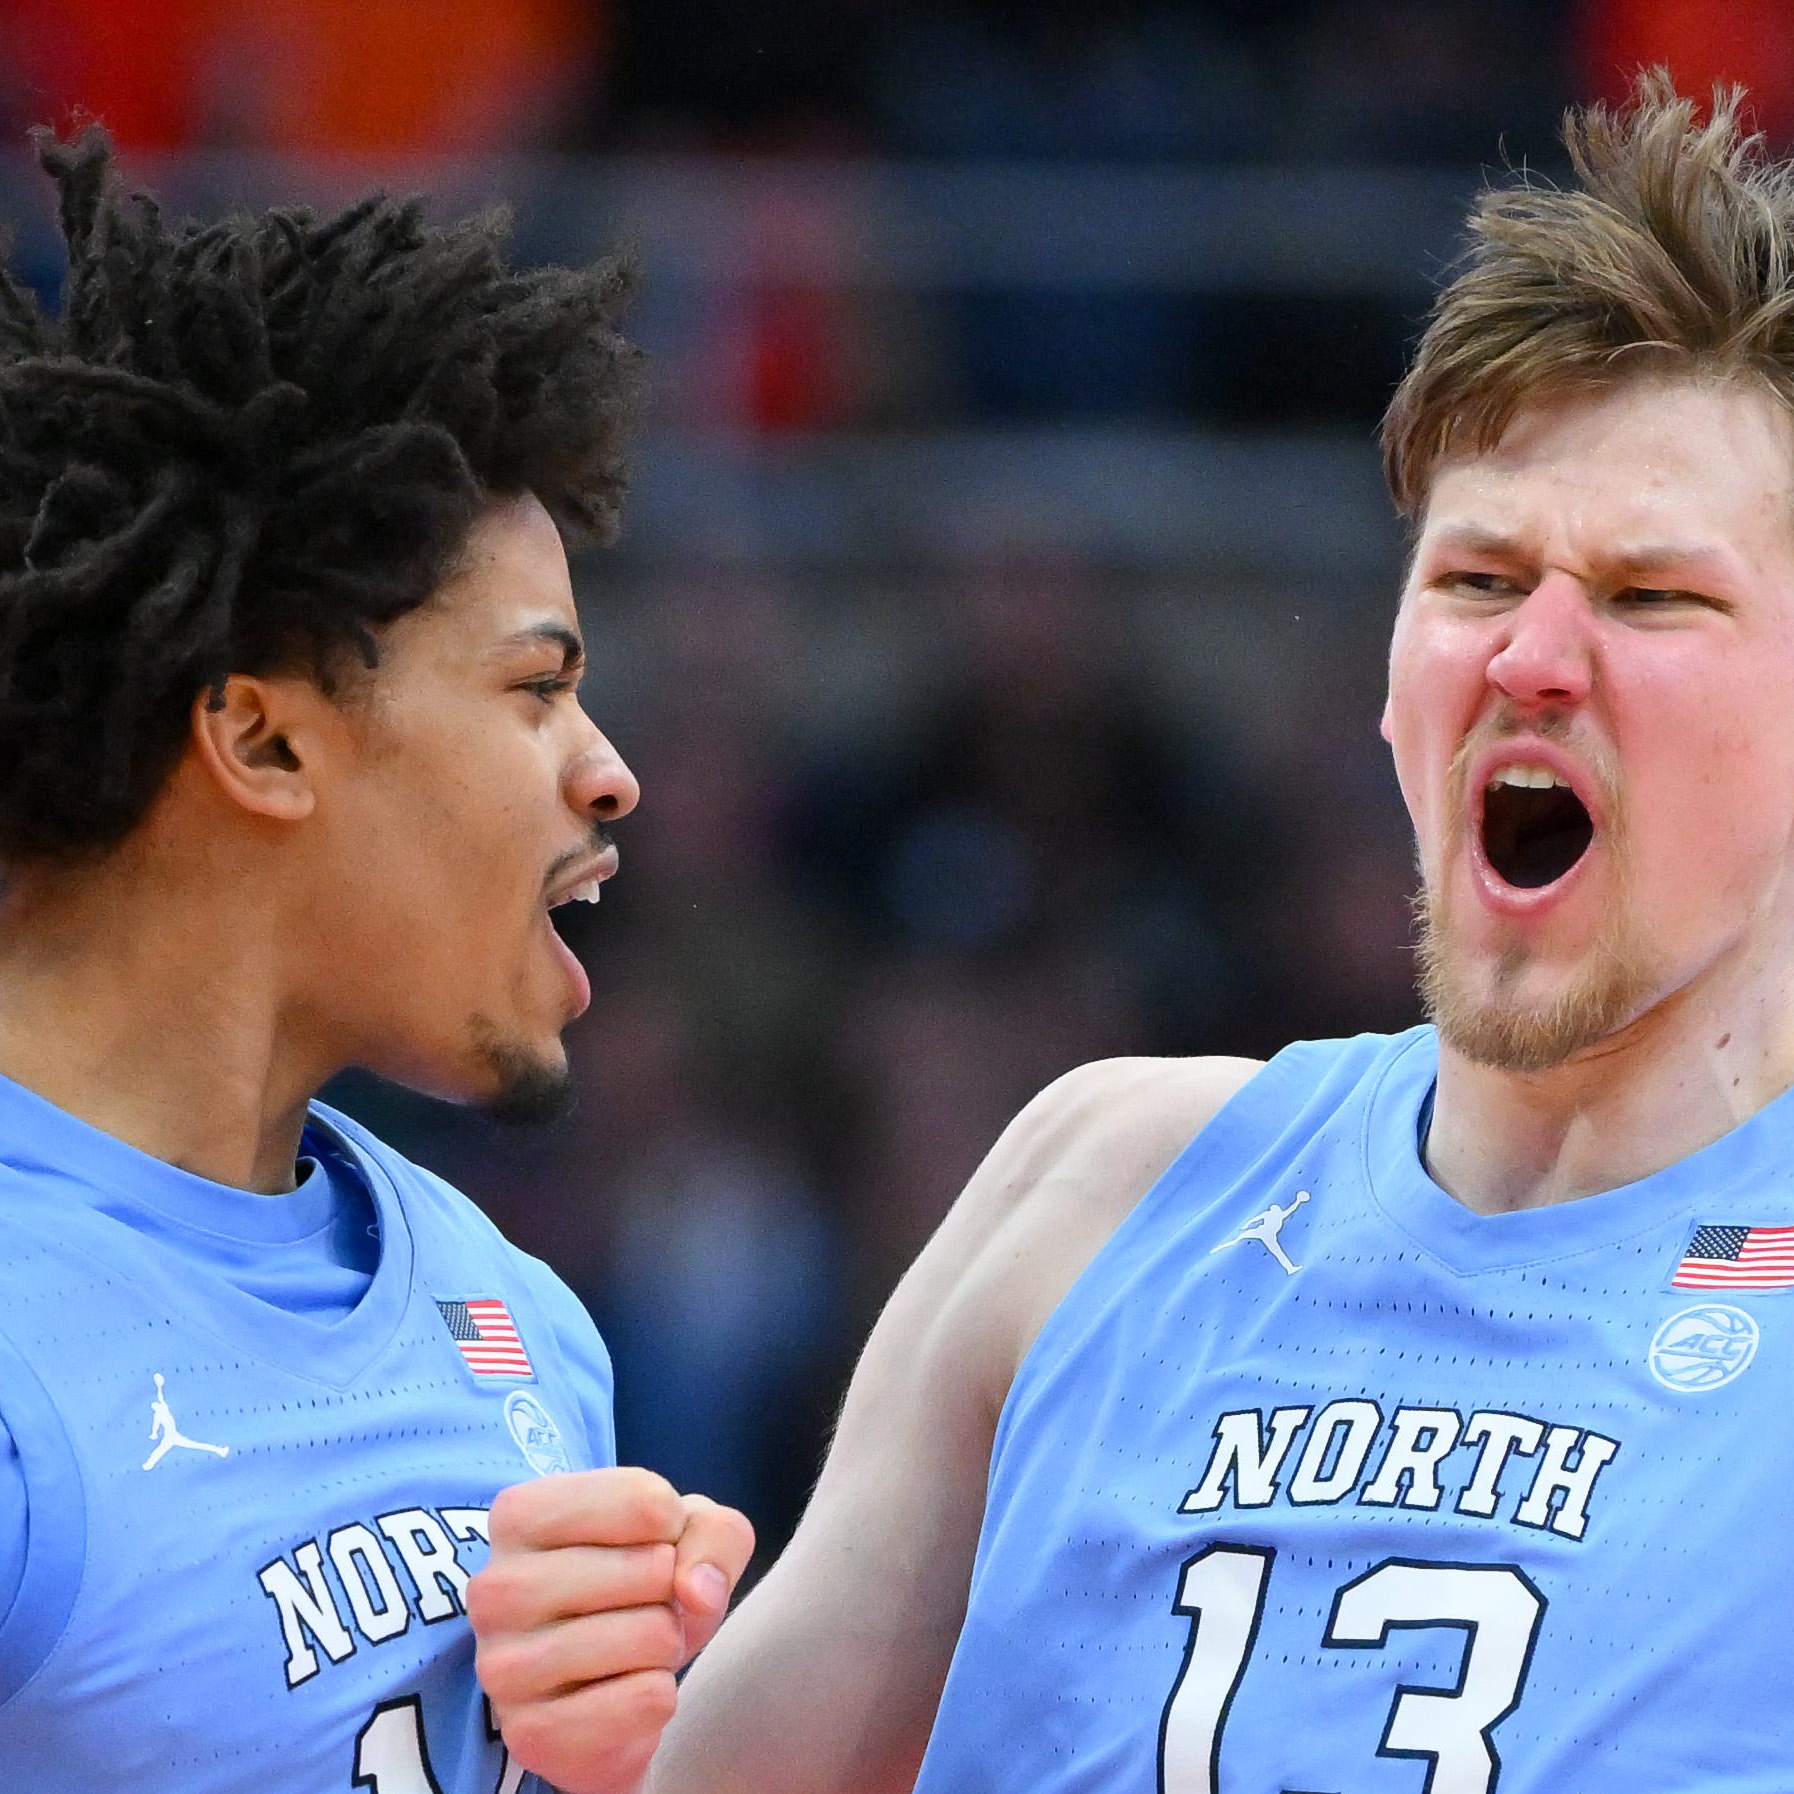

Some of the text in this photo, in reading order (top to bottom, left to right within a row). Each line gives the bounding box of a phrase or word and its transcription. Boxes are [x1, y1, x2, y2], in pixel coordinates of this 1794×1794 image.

[1668, 1333, 1753, 1356] ACC
[1178, 1397, 1620, 1541] NORTH
[256, 1505, 491, 1691] NOR
